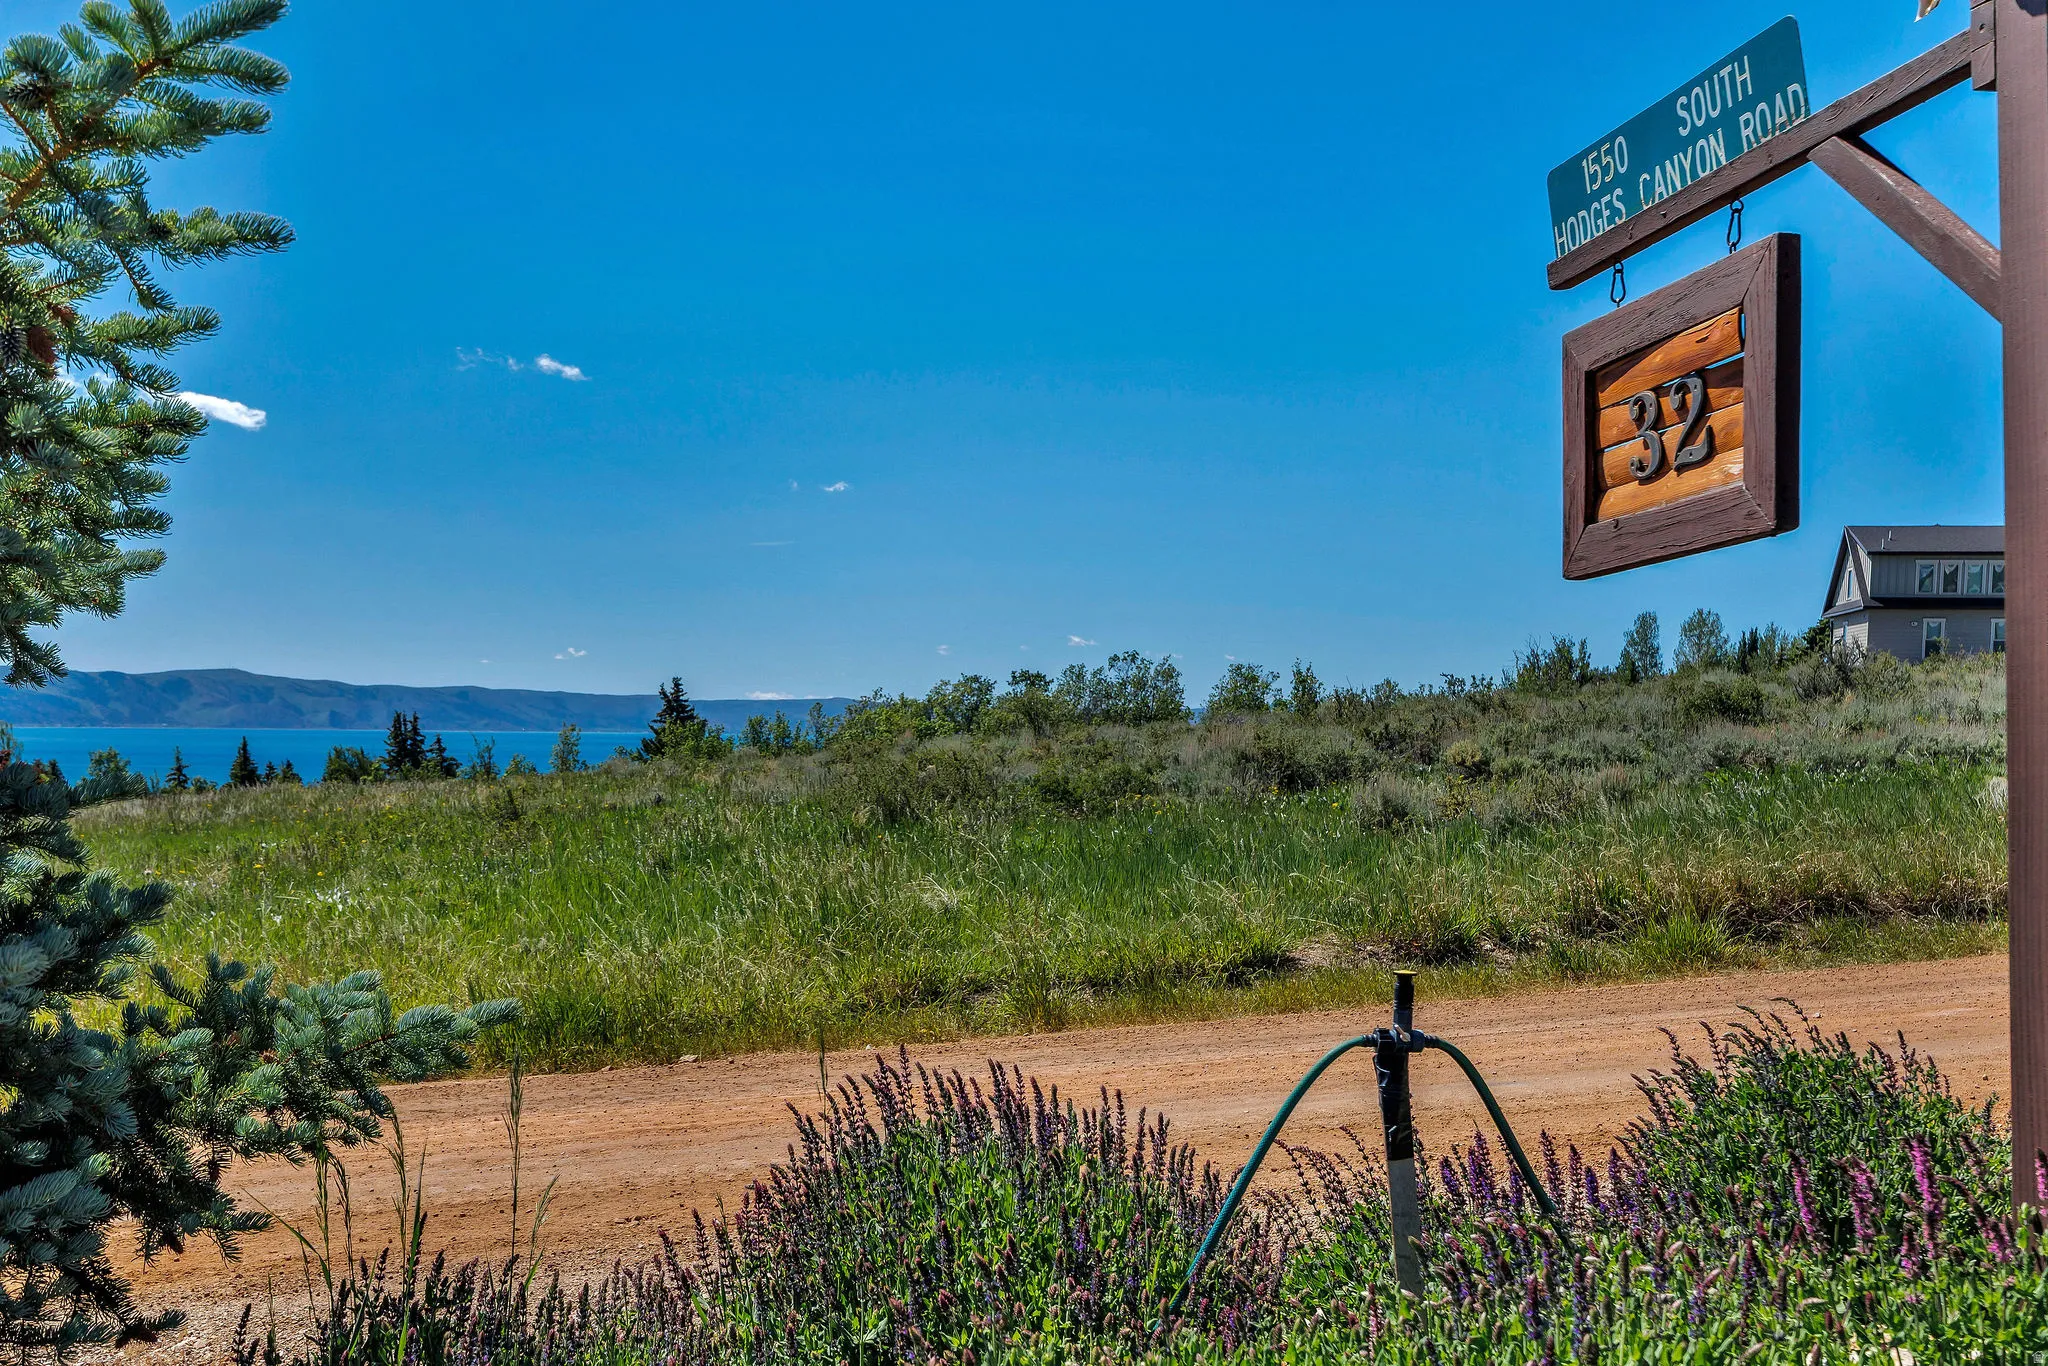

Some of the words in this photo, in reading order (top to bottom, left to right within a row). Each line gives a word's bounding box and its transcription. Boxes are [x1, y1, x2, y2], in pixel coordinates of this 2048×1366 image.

[1554, 187, 1627, 259] HODGES
[1639, 128, 1727, 210] CANYON
[1739, 83, 1806, 152] ROAD
[1581, 135, 1628, 194] 1550
[1676, 55, 1753, 137] SOUTH
[1629, 376, 1714, 480] 32
